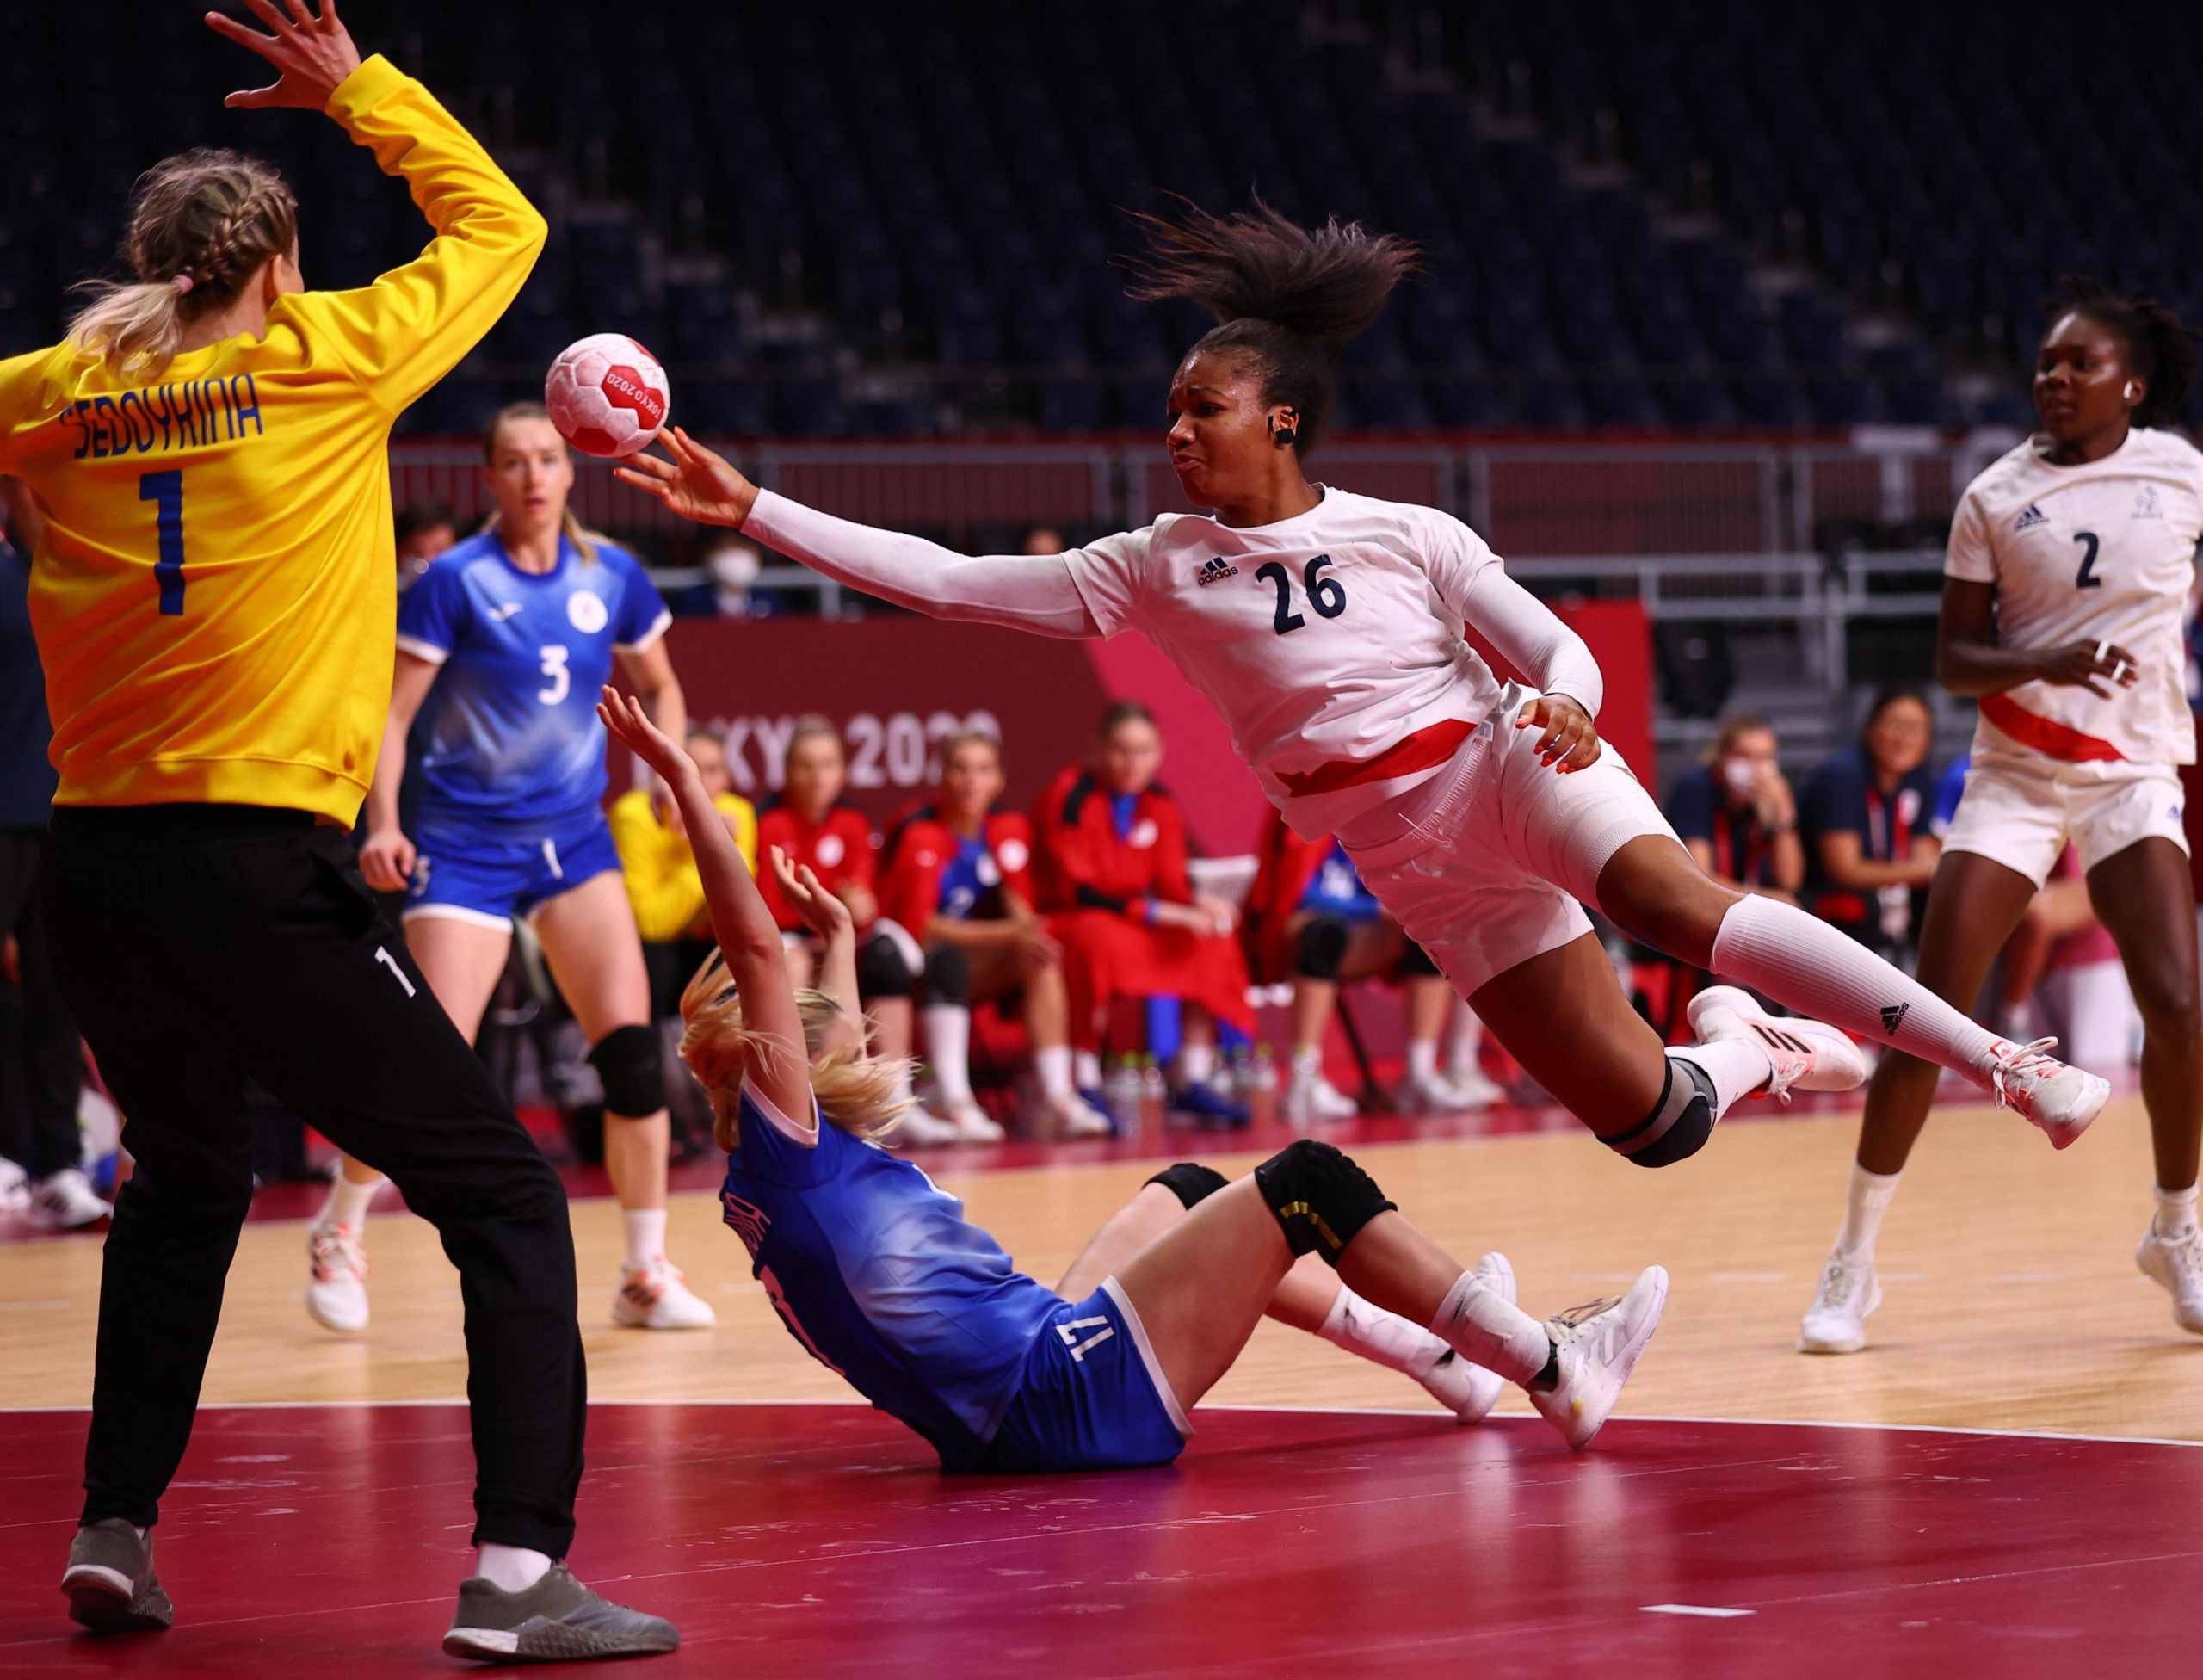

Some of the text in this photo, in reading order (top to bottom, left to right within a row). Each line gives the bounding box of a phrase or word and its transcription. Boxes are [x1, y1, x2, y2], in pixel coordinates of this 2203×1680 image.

[607, 373, 662, 419] TOKYO 2020
[139, 470, 186, 616] 1
[2073, 532, 2101, 590] 2
[1198, 566, 1239, 585] adidas
[1256, 553, 1347, 635] 26
[537, 644, 571, 706] 3
[374, 945, 417, 998] 1
[1055, 1314, 1115, 1362] 17
